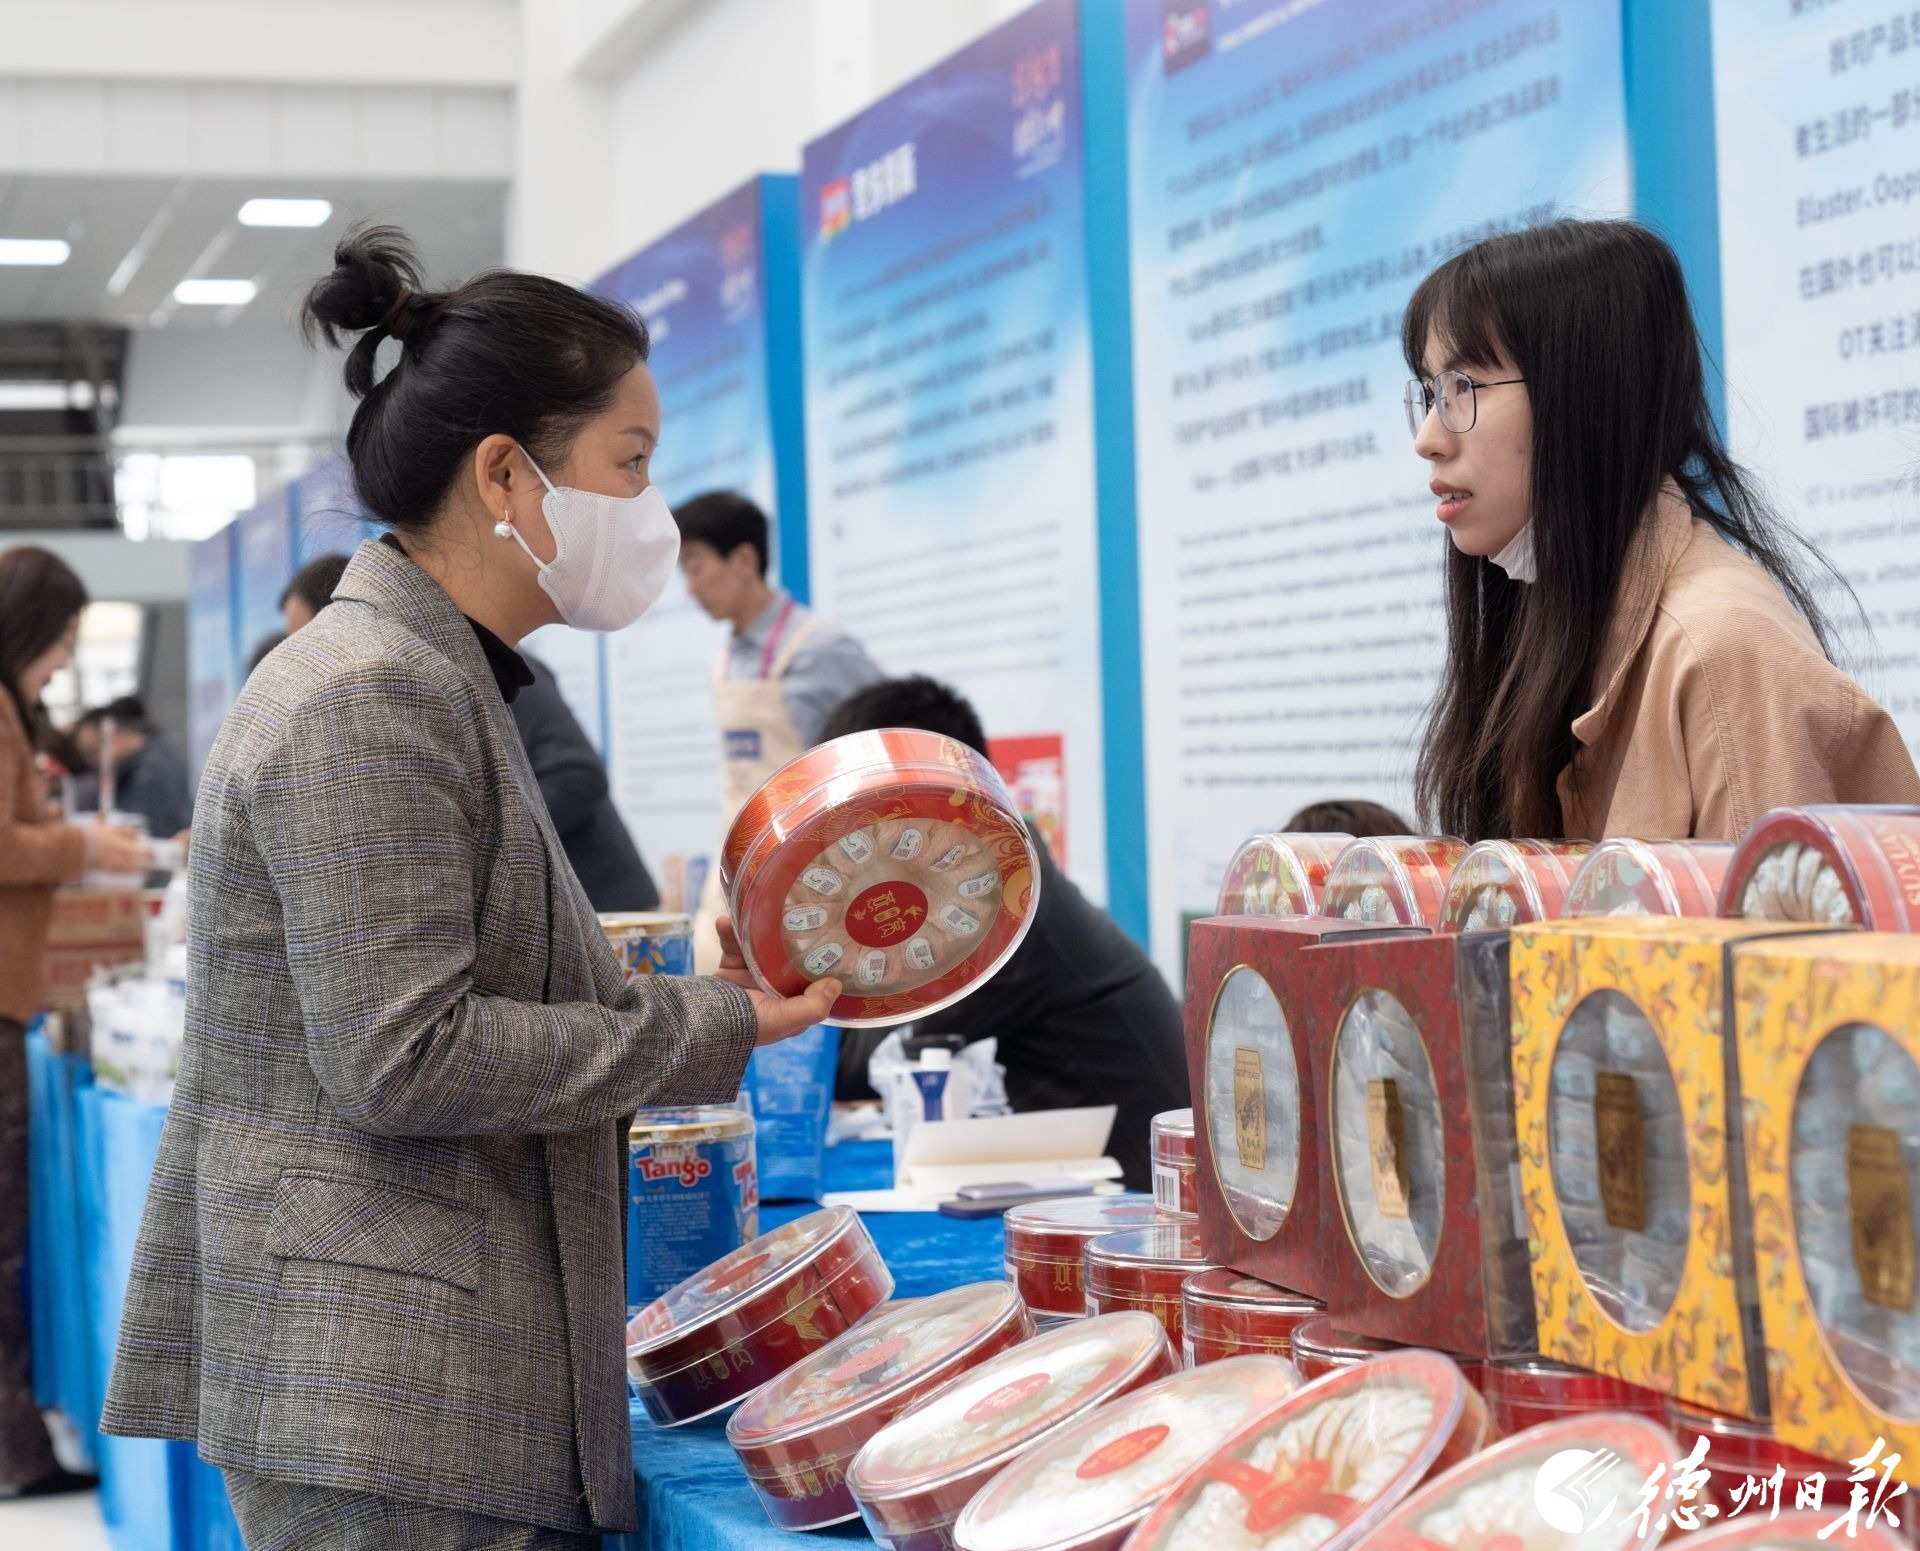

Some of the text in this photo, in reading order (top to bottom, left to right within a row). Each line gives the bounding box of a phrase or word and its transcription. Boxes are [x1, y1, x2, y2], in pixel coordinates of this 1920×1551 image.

[1800, 234, 1920, 301] 在国外也可以
[635, 1157, 711, 1187] Tango
